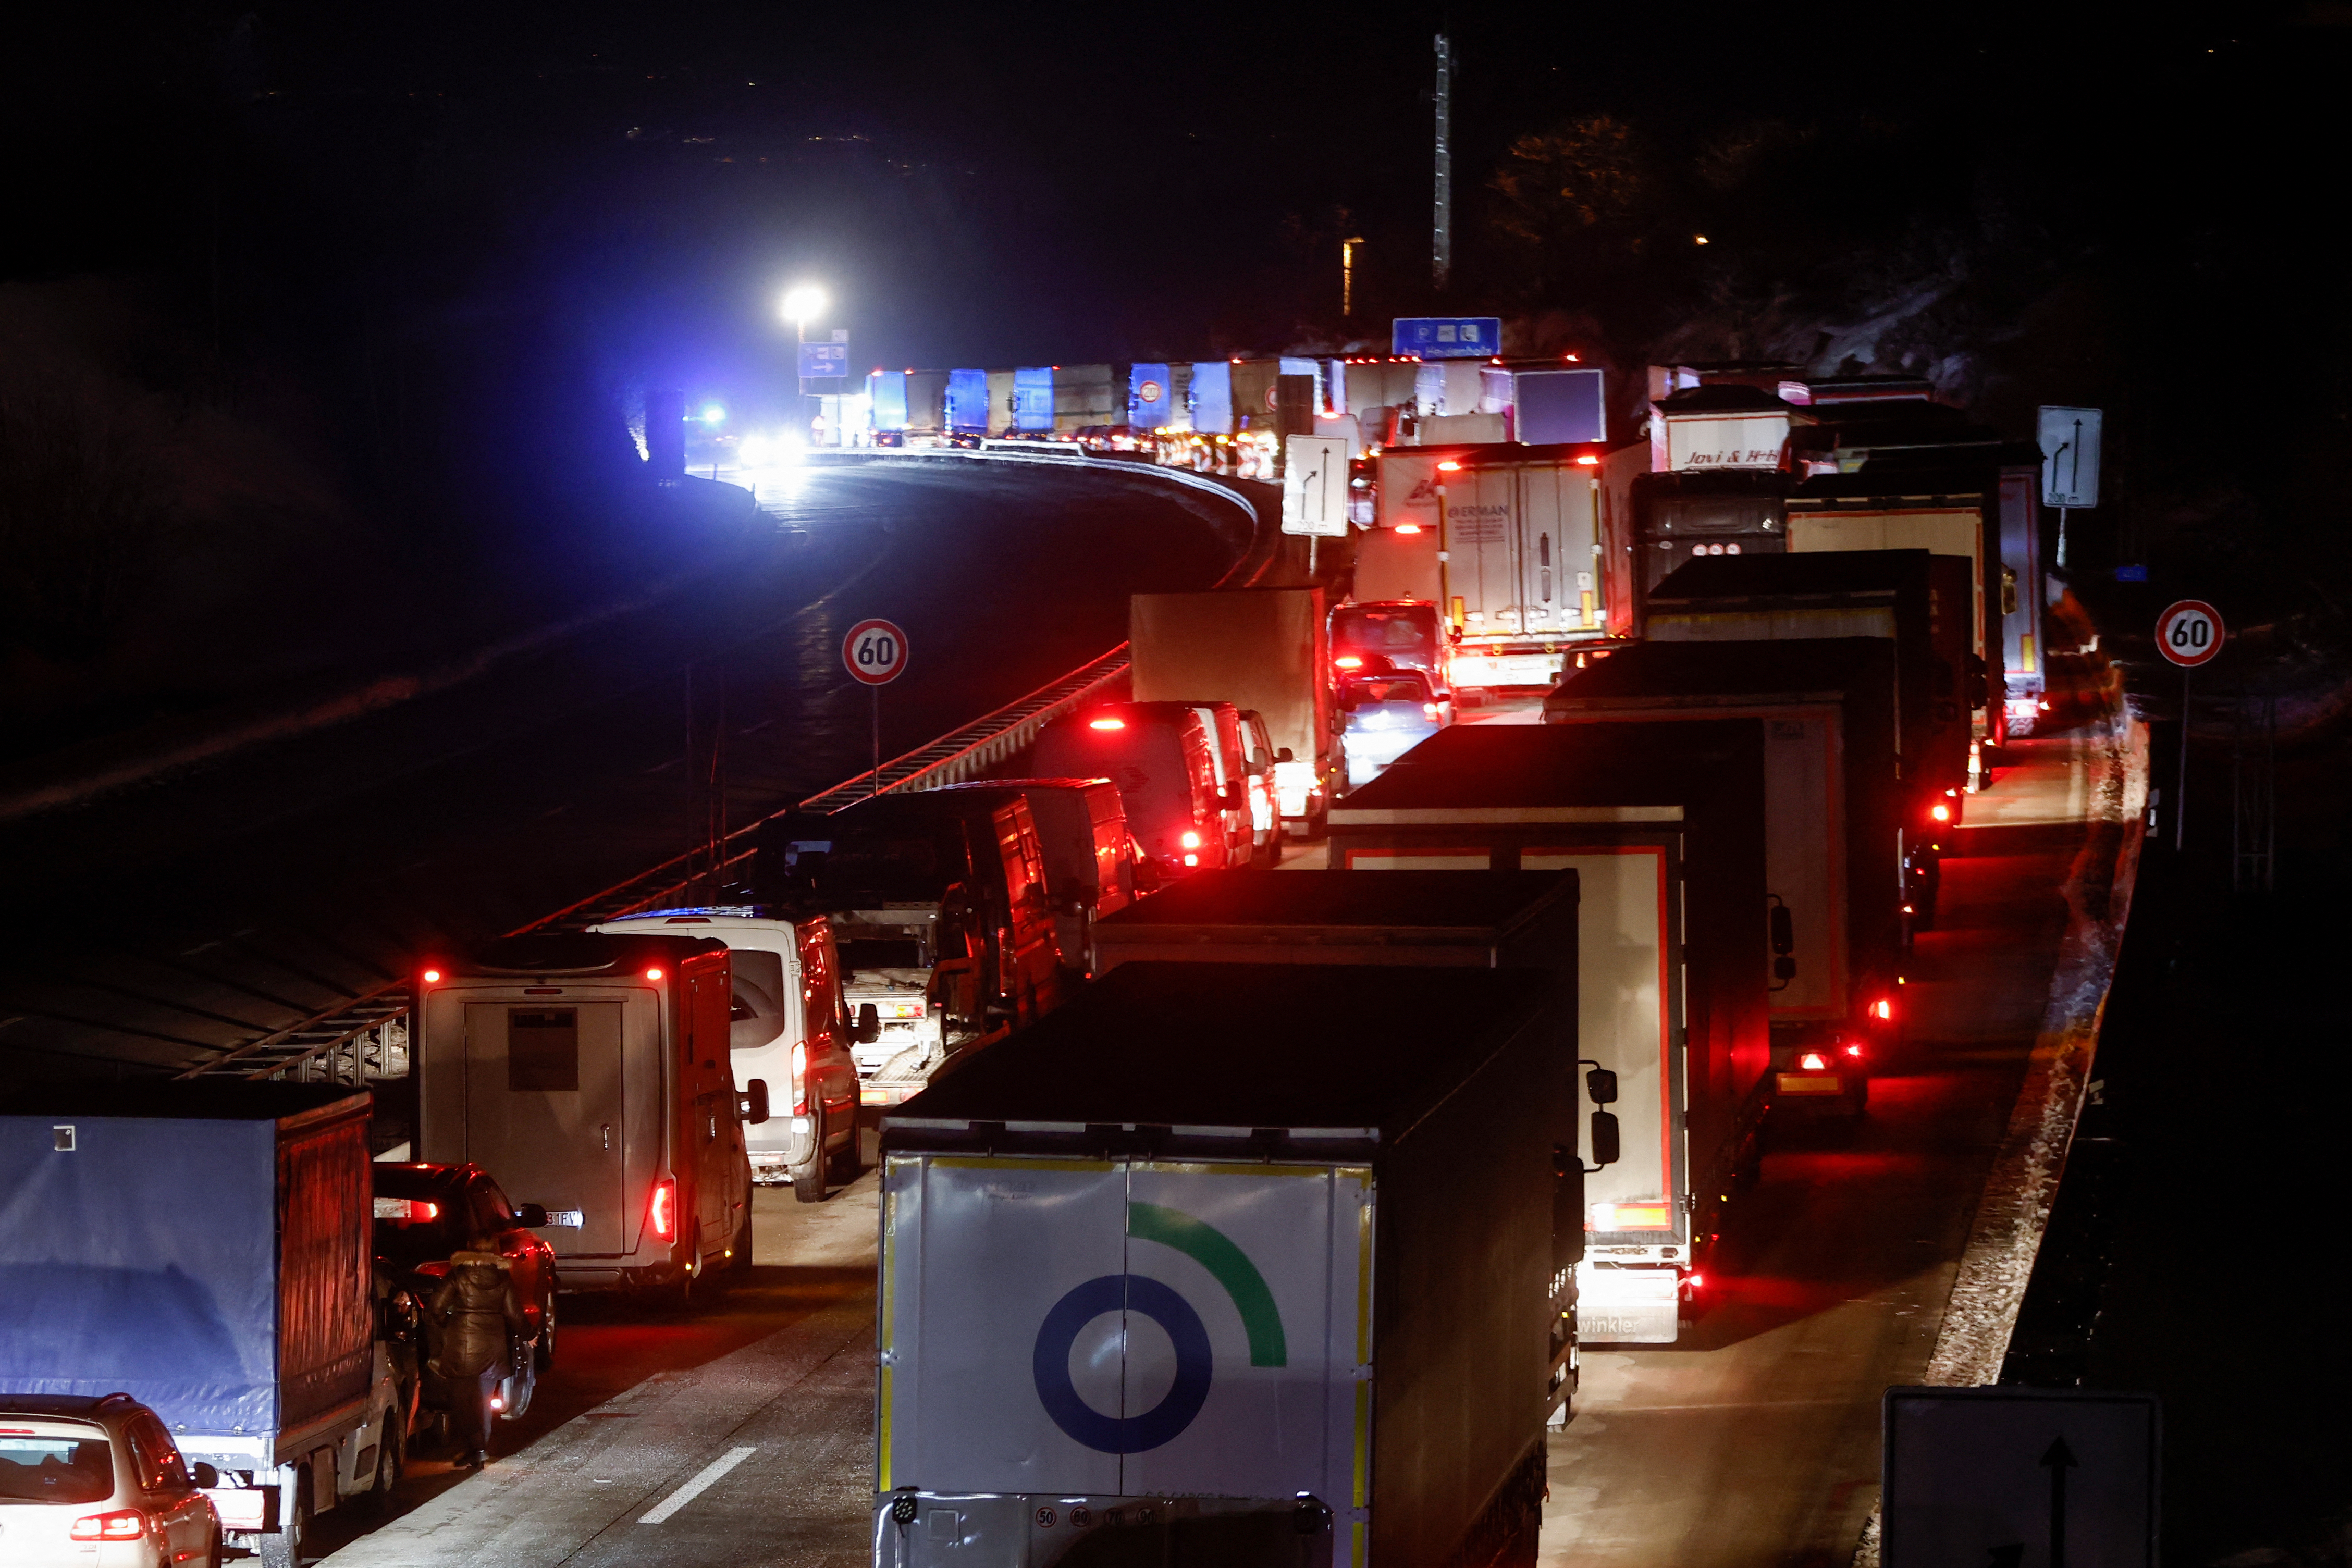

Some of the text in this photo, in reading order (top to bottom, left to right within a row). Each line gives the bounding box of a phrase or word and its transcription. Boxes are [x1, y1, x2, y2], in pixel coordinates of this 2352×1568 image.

[2172, 619, 2208, 648] 60
[858, 637, 893, 666] 60
[1039, 1510, 1053, 1524] 50
